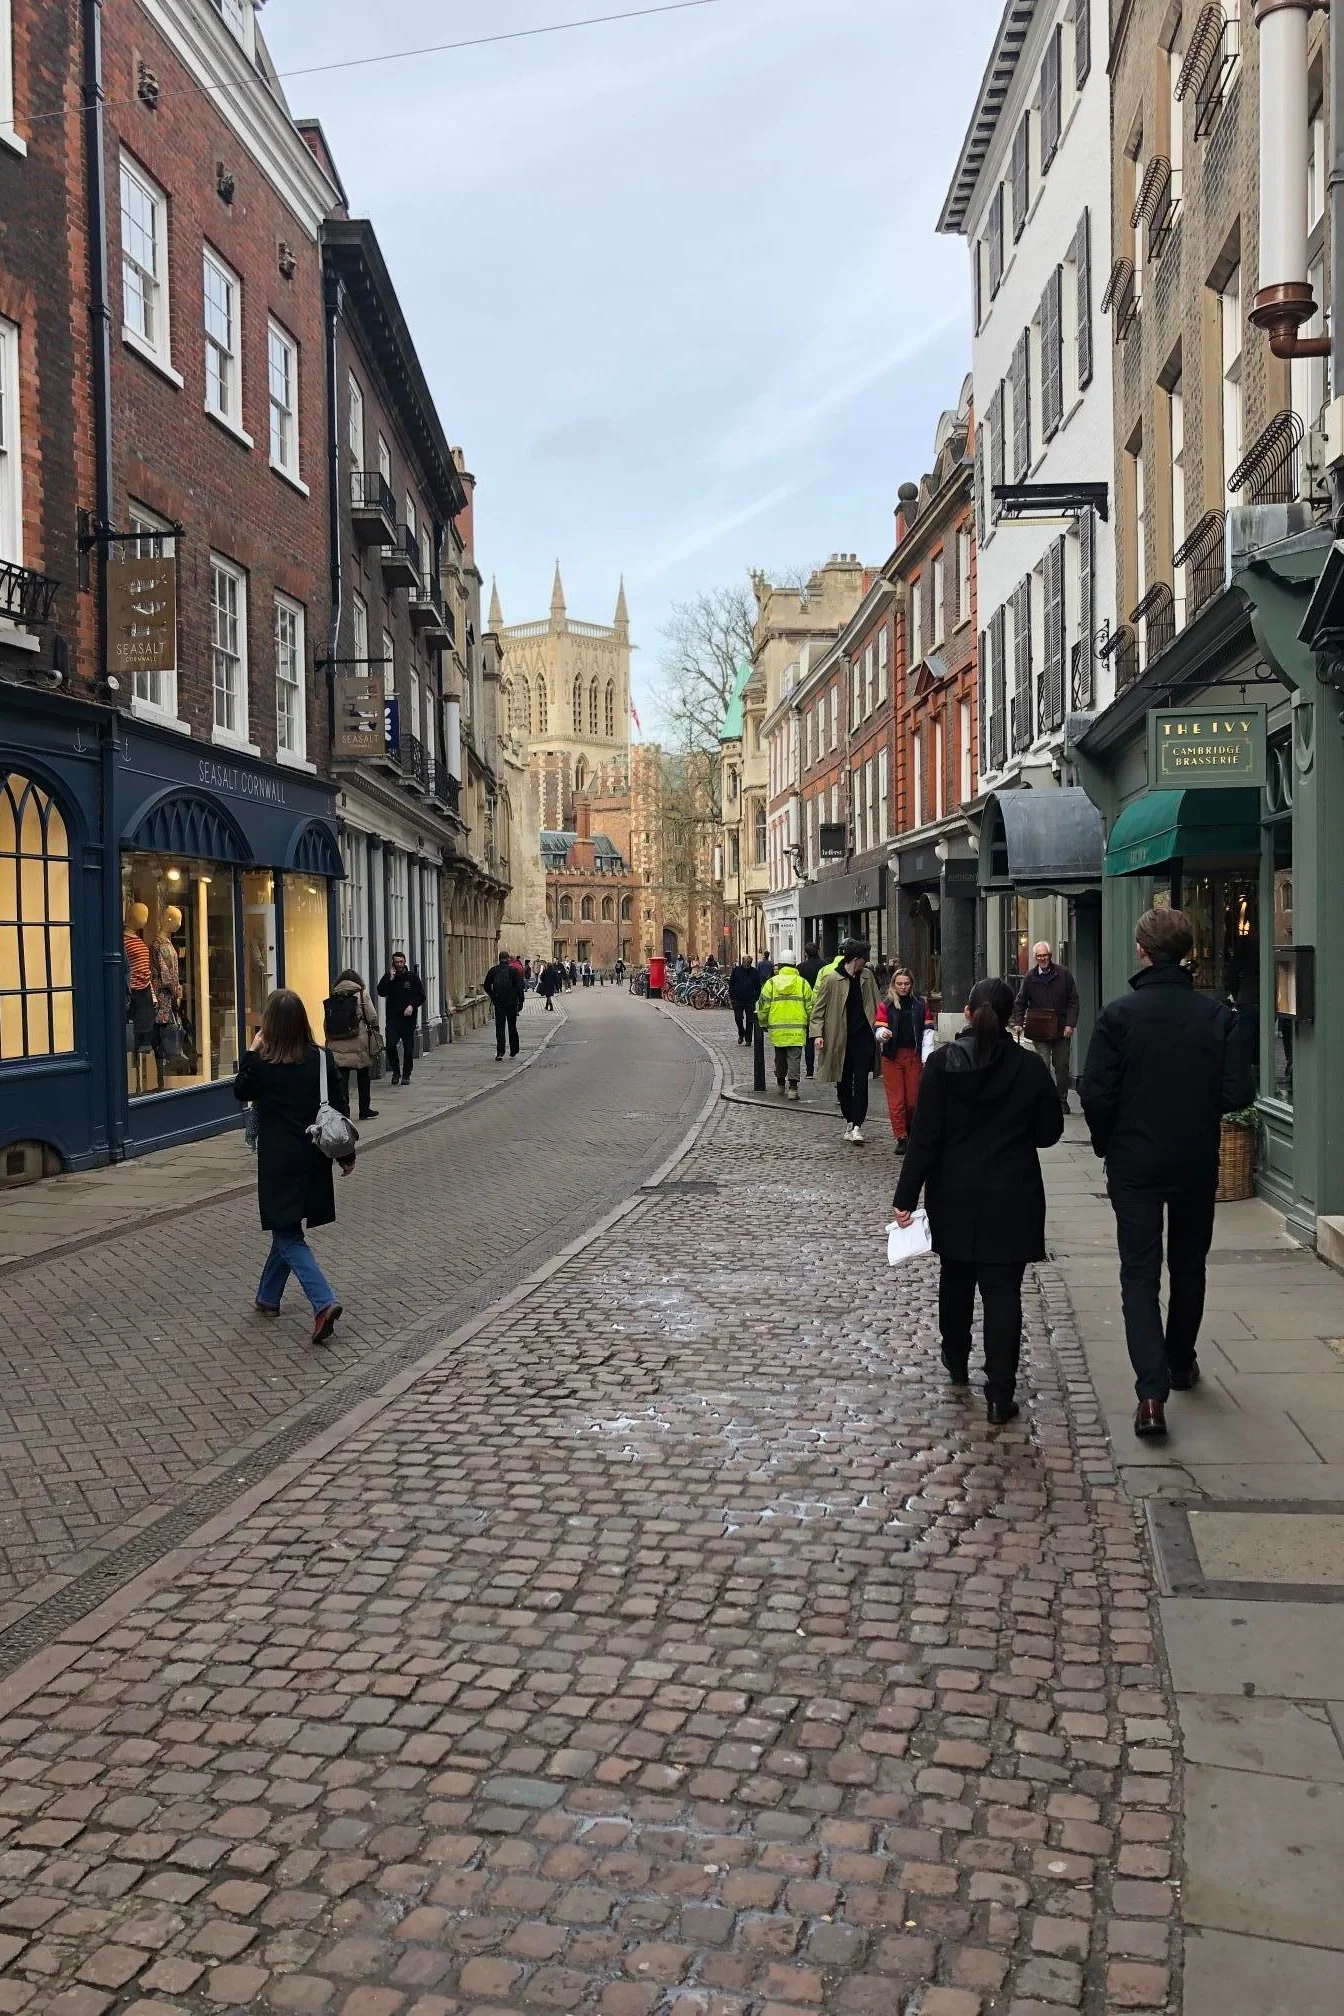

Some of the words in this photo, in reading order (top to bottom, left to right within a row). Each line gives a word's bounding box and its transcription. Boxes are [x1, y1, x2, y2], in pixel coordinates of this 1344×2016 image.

[116, 642, 165, 656] SEASALT
[1163, 723, 1201, 735] THE
[1212, 721, 1251, 733] IVY
[342, 734, 379, 744] SEASALT
[1173, 746, 1241, 756] CAMBRIDGE
[1176, 756, 1239, 766] BRASSERIE
[199, 760, 238, 790] SEASALT
[242, 772, 286, 804] CORNWALL
